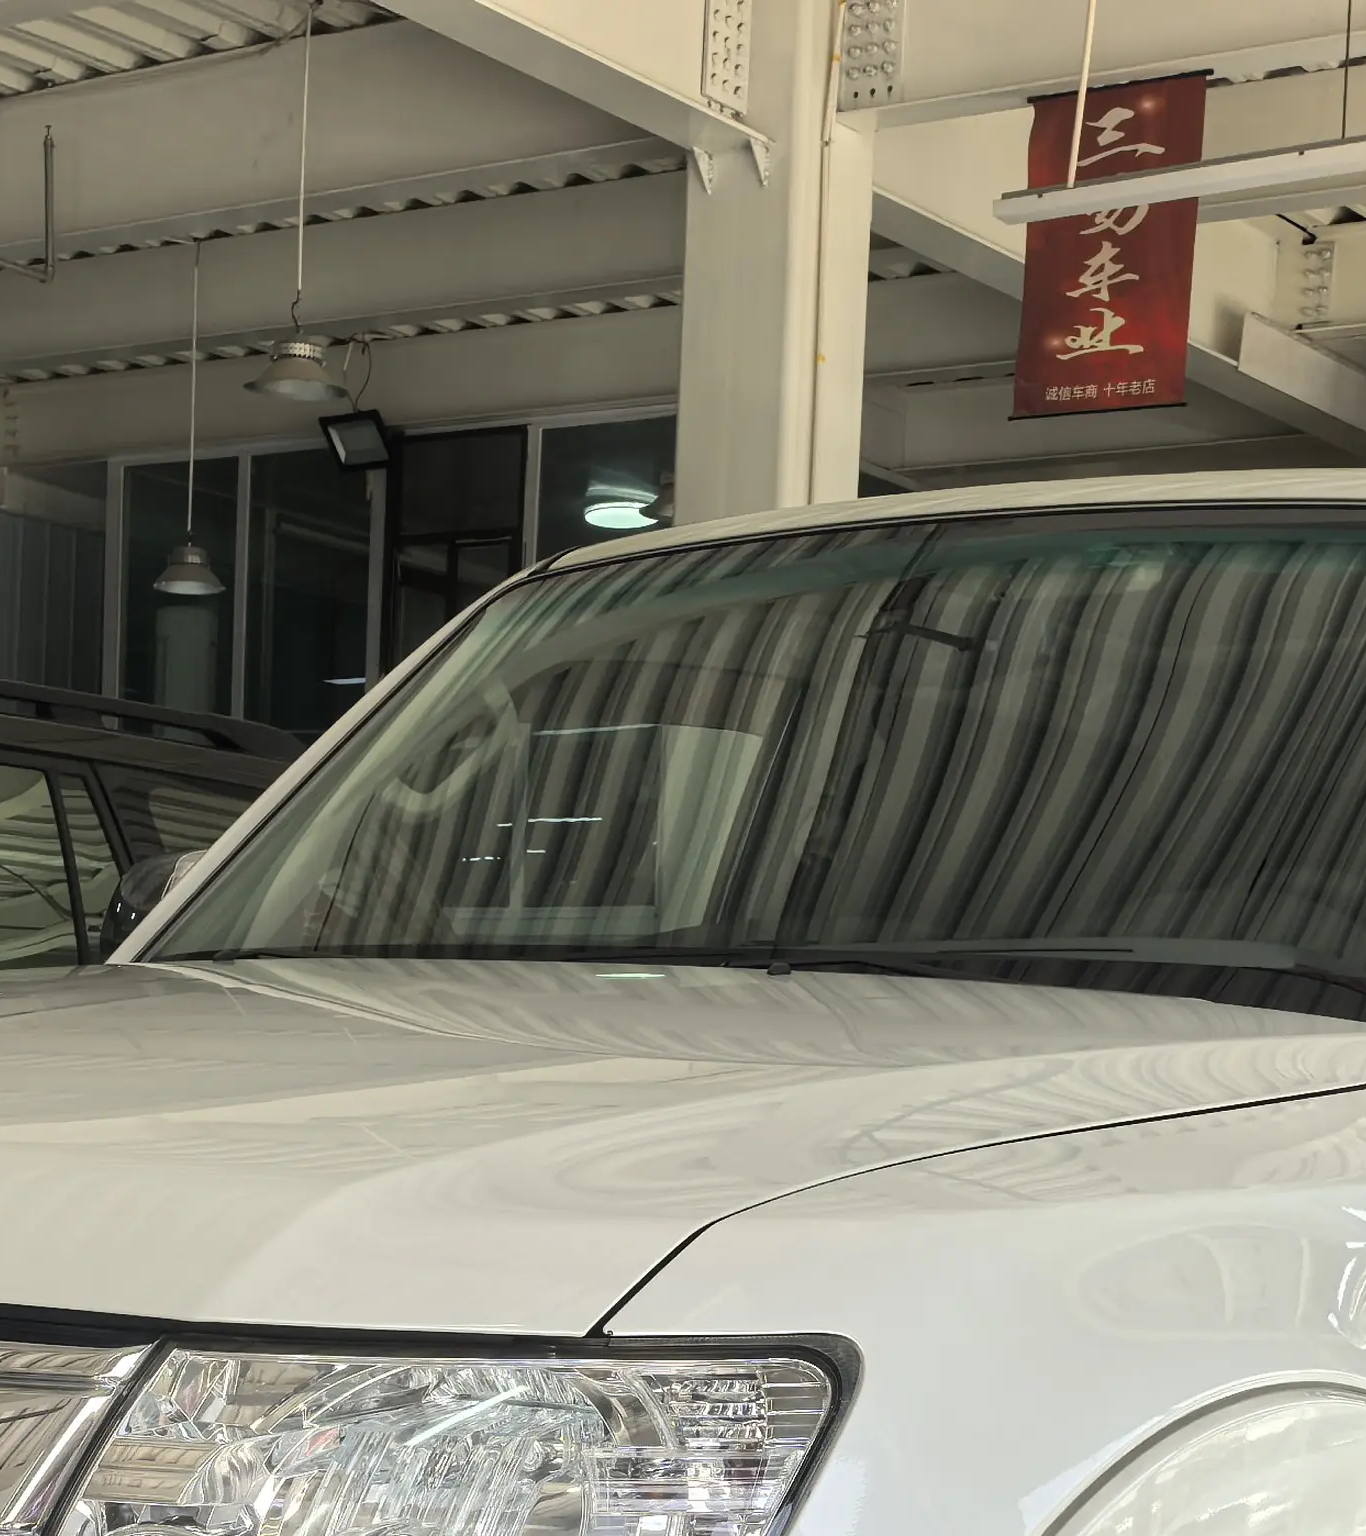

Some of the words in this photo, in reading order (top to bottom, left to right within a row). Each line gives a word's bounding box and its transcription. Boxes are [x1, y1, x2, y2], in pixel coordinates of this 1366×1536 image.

[1045, 383, 1097, 400] 诚信车商
[1103, 379, 1156, 397] 十年老店
